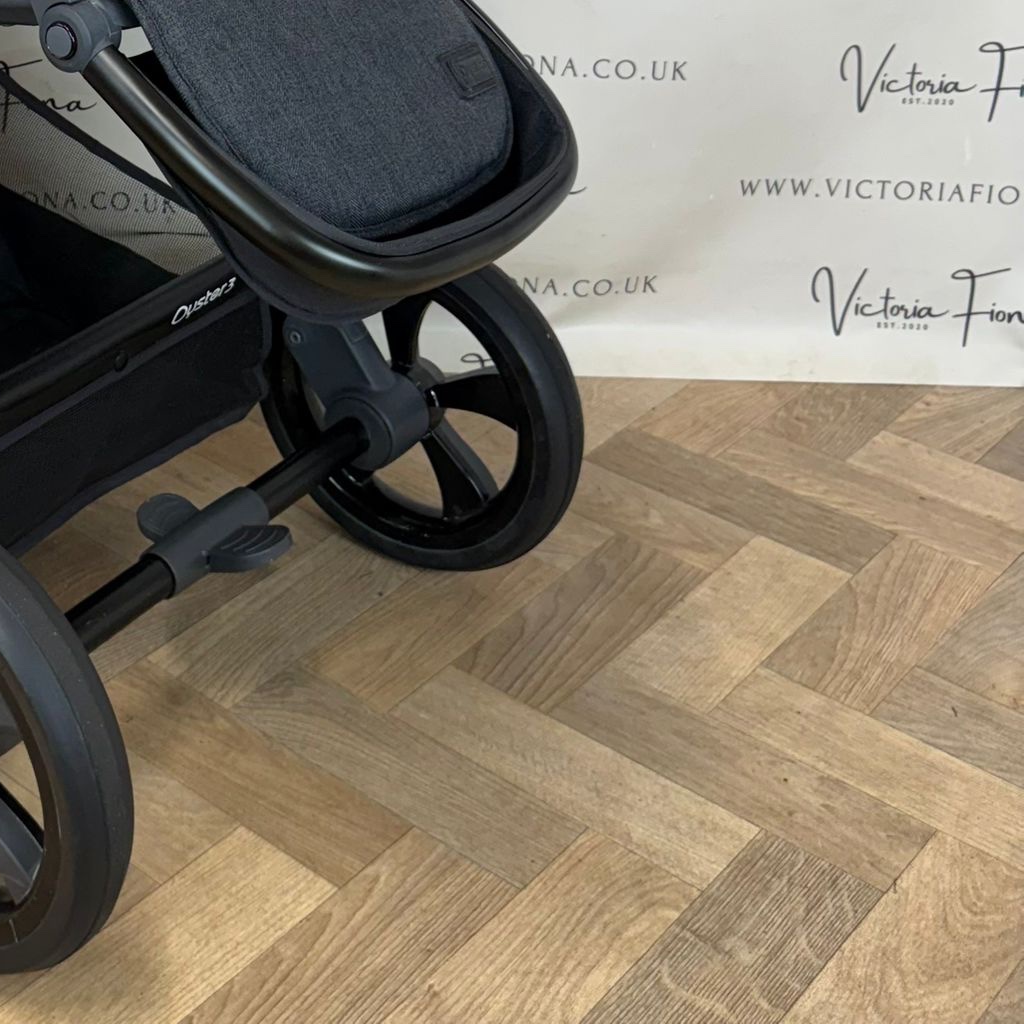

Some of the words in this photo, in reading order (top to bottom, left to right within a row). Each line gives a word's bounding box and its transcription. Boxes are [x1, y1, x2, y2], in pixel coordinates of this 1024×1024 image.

[840, 43, 976, 113] Victoria
[902, 97, 954, 105] EST.2020
[811, 266, 948, 336] Victoria
